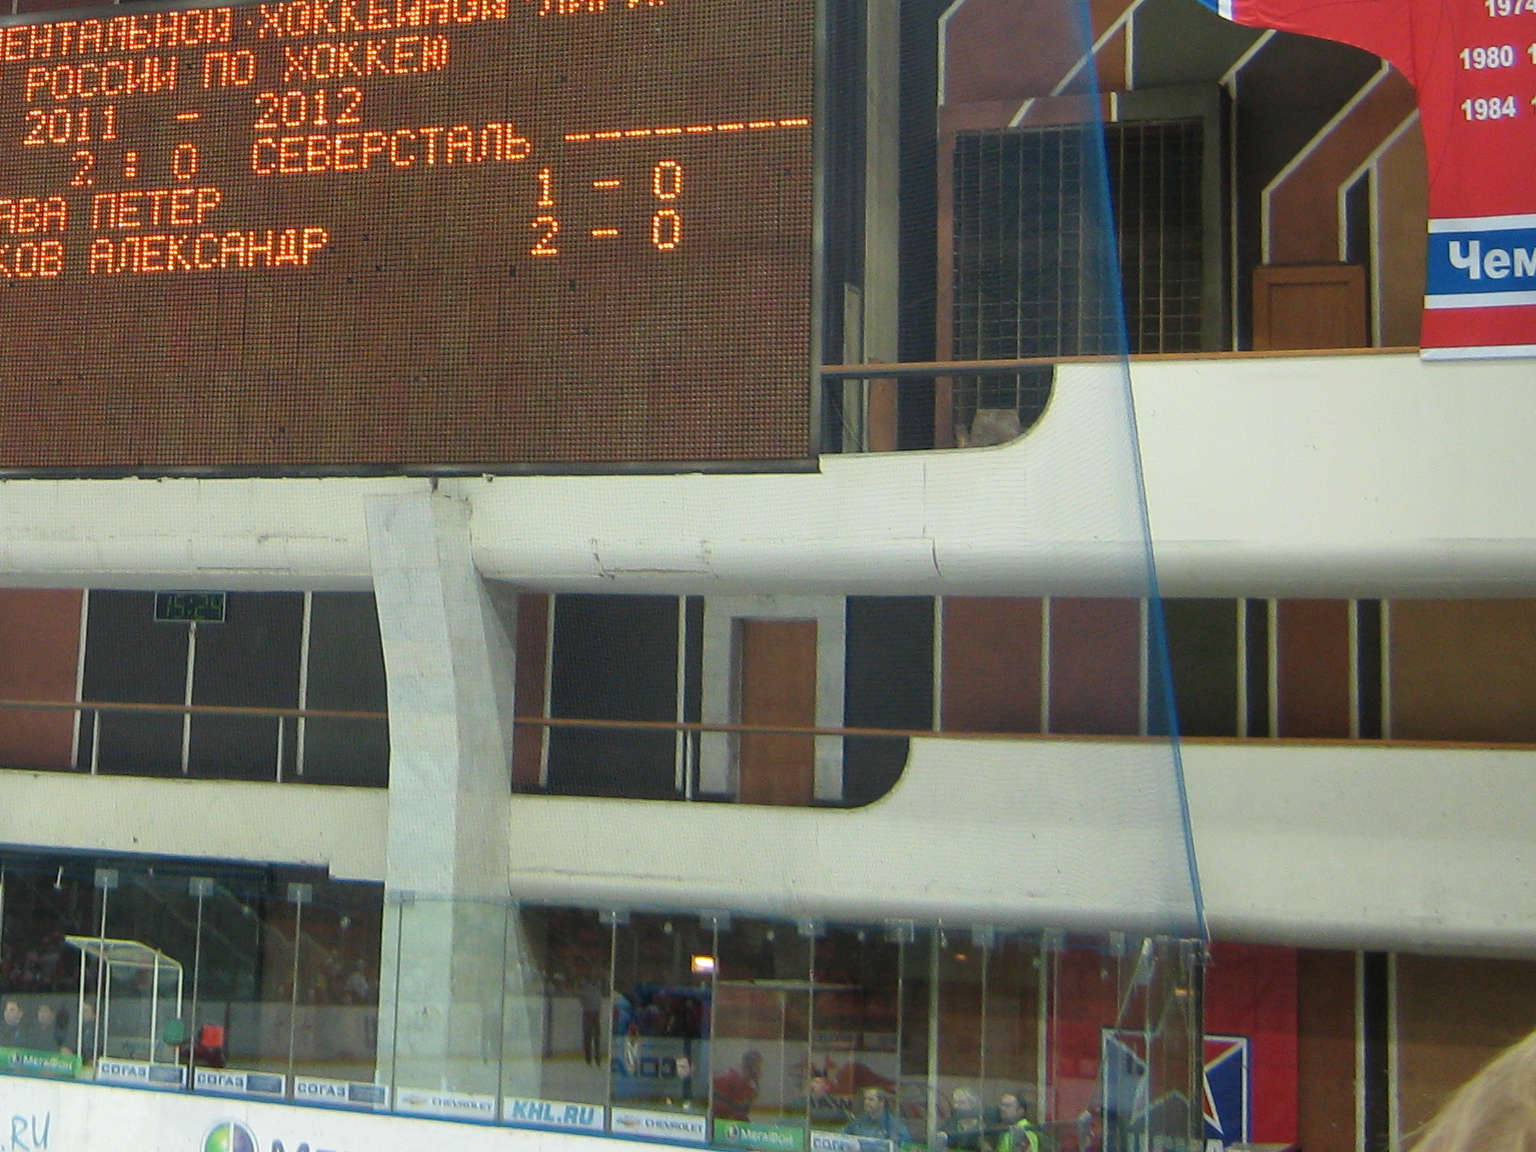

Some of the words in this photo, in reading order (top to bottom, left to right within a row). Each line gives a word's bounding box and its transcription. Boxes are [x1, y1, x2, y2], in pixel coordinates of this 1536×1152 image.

[26, 56, 177, 102] РОССИИ
[202, 49, 256, 90] ПО
[283, 34, 449, 83] ХОККЕЮ
[1459, 45, 1514, 70] 1980
[23, 105, 119, 146] 2011
[253, 86, 364, 130] 2012
[1461, 95, 1517, 121] 1984
[250, 122, 532, 176] СЕВЕРСТАЛЬ
[92, 187, 222, 229] ПЕТЕР
[87, 226, 329, 275] АЛЕКСАНДР
[101, 1062, 146, 1077] СОГАЗ
[197, 1073, 244, 1089] СОГАЗ
[298, 1083, 346, 1098] СОГАЗ
[514, 1099, 595, 1125] KHL.RU
